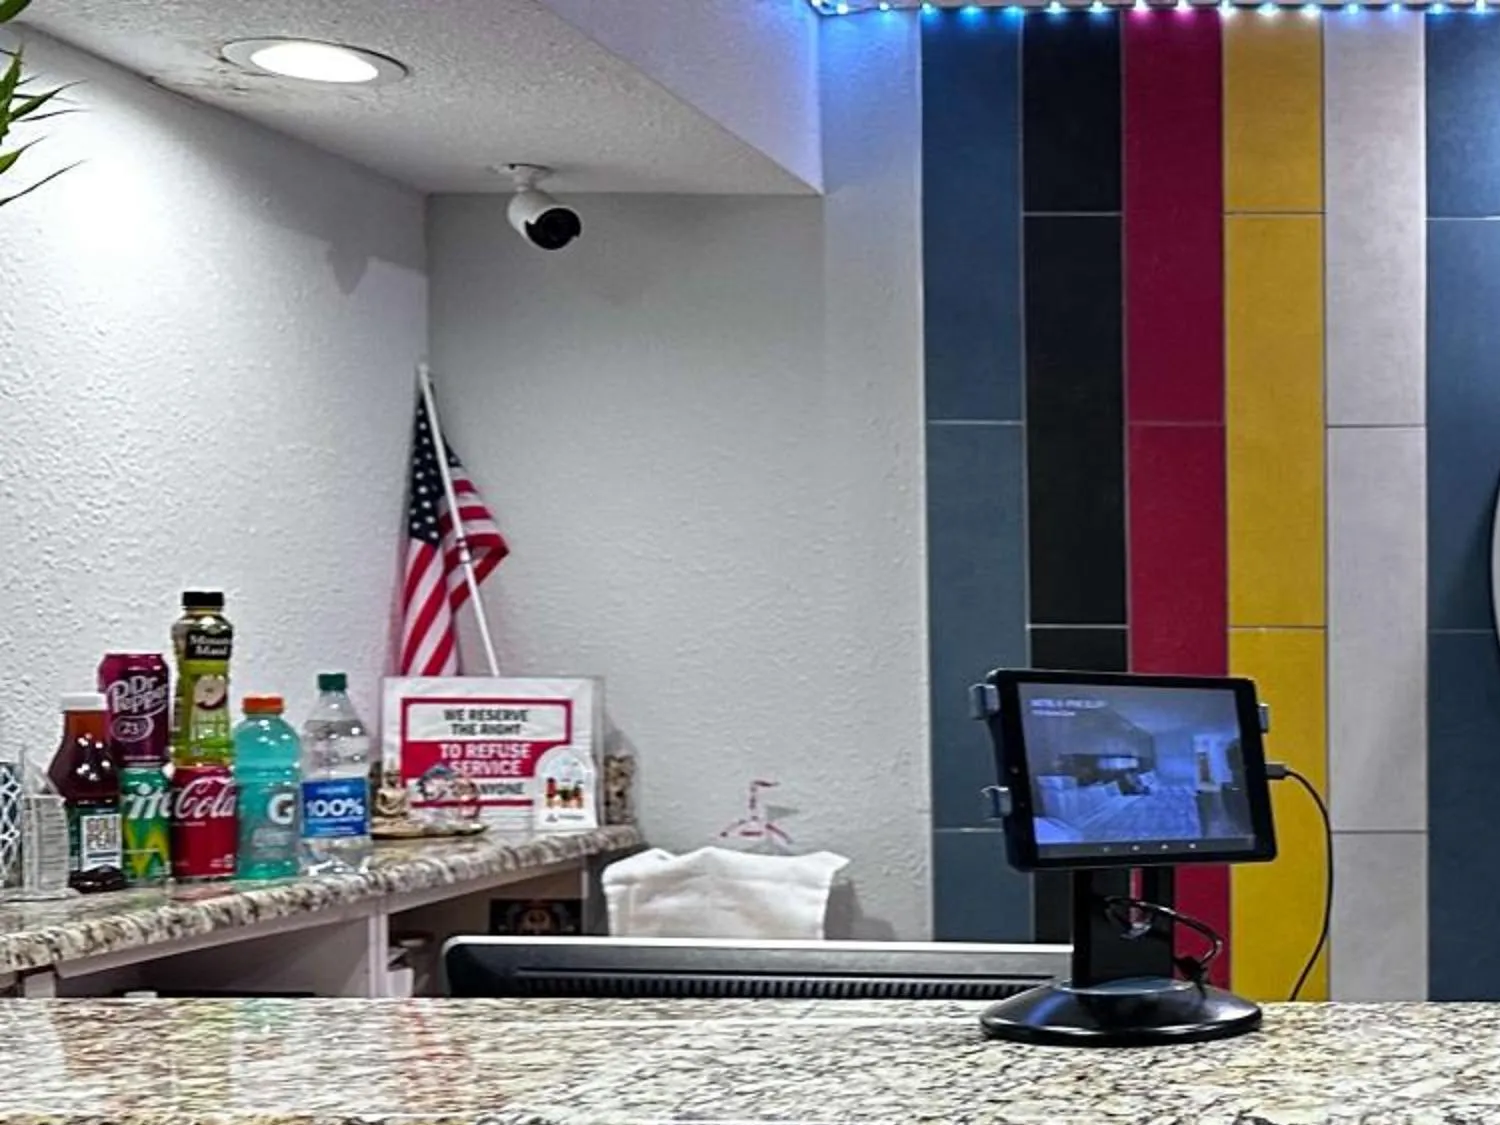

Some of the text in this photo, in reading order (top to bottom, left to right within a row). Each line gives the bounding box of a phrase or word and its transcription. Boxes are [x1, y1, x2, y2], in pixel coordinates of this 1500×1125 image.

[130, 675, 158, 695] Dr
[444, 709, 529, 722] WE RESERVE
[119, 721, 139, 735] 23
[451, 723, 521, 735] THE RIGHT
[440, 744, 532, 759] TO REFUSE
[450, 760, 522, 775] SERVICE
[268, 793, 295, 825] G
[306, 797, 365, 817] 100%
